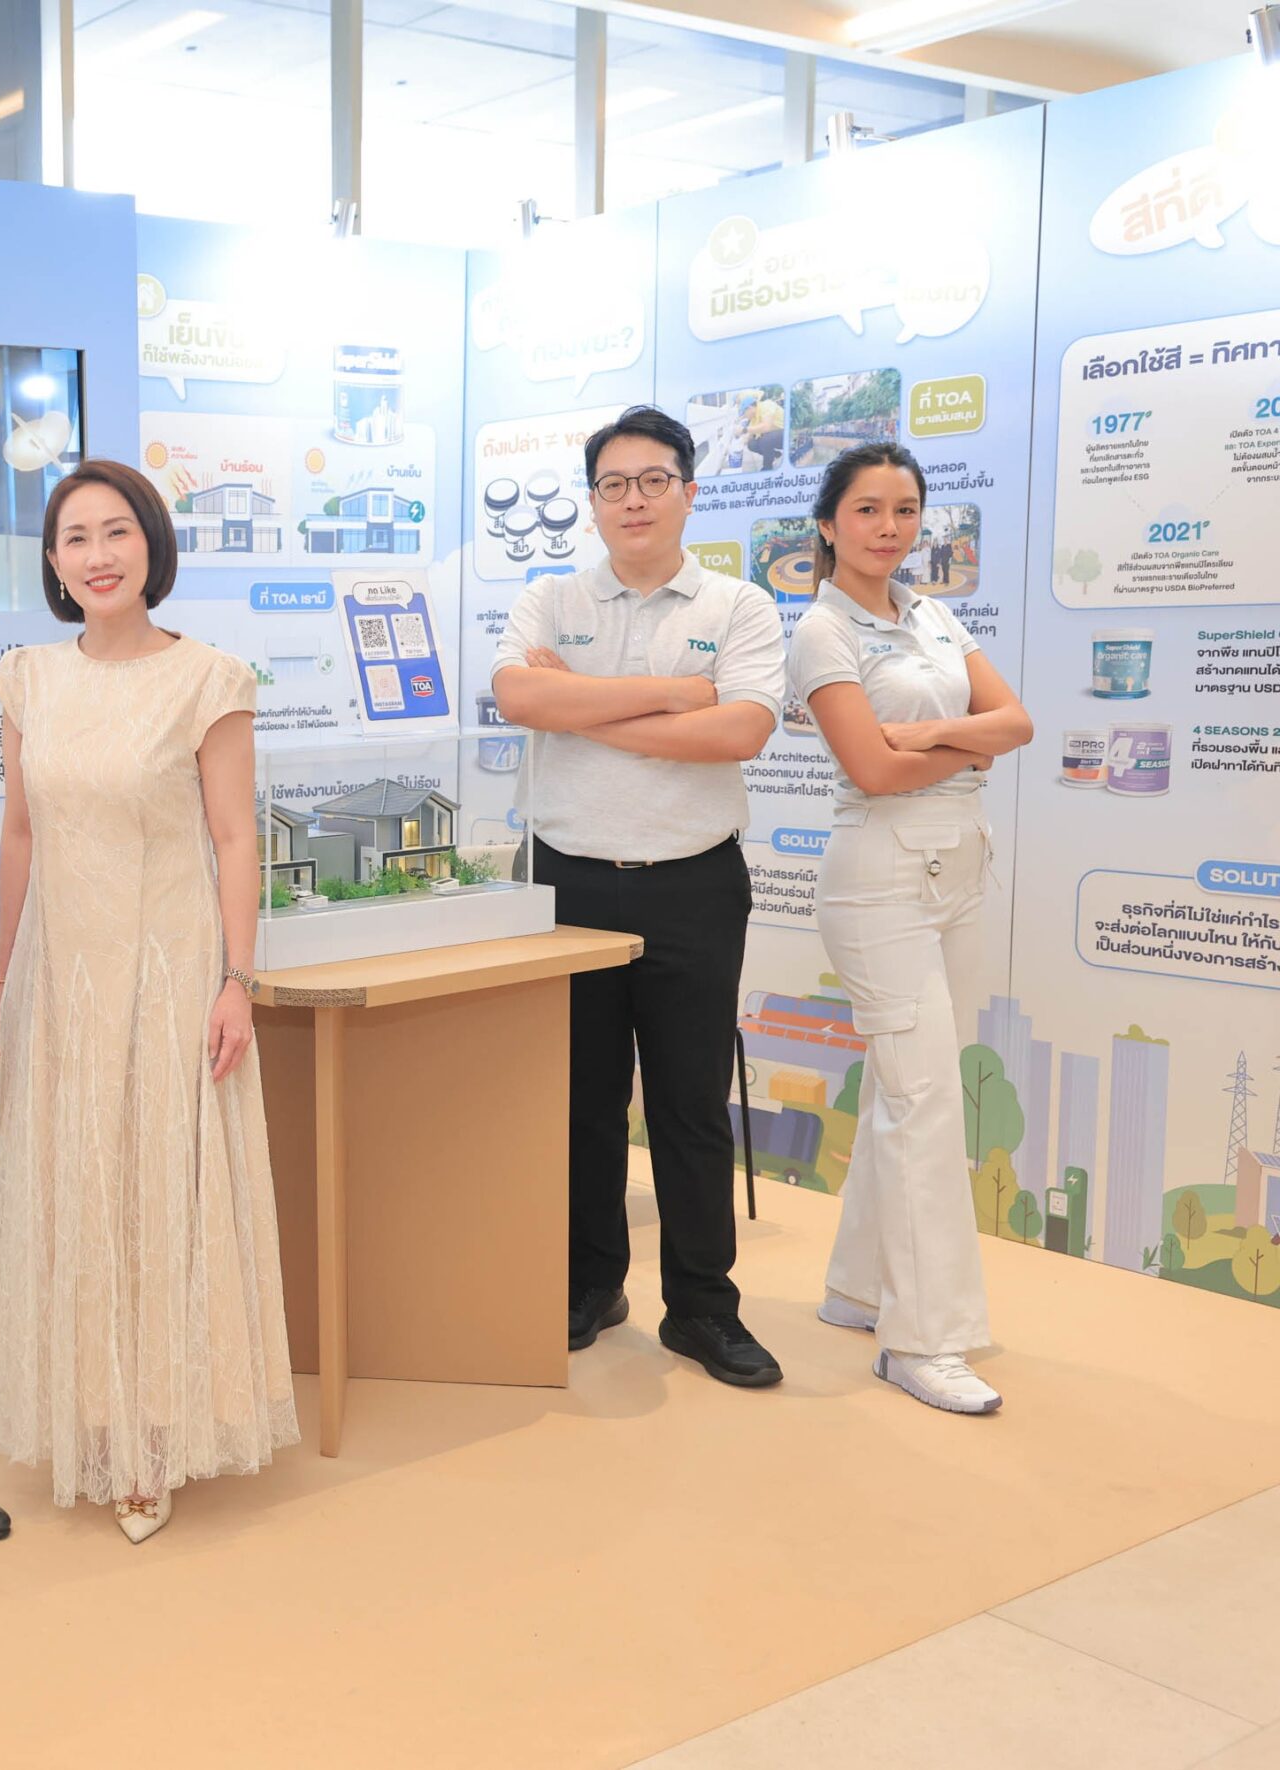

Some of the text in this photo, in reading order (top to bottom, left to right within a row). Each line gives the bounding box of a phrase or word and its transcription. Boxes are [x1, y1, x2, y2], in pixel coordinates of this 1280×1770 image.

[1082, 345, 1182, 381] เลือกใช้สี
[1189, 353, 1204, 365] =
[919, 386, 973, 409] ที่ TOA
[1092, 411, 1145, 435] 1977
[1255, 428, 1272, 436] TOA
[1238, 441, 1256, 450] TOA
[1133, 472, 1150, 481] ESG
[1148, 521, 1201, 543] 2021
[703, 554, 733, 566] TOA
[1171, 552, 1200, 560] Organic
[379, 585, 397, 594] Like
[1187, 583, 1235, 592] BioPreferred
[259, 587, 326, 605] ที่ TOA เรามี
[1197, 630, 1275, 642] SuperShield
[687, 639, 717, 653] TOA
[1197, 646, 1239, 657] จากพืช
[413, 681, 432, 692] TOA
[1195, 684, 1251, 695] มาตรฐาน
[1192, 725, 1201, 735] 4
[1204, 726, 1269, 737] SEASONS
[1081, 740, 1105, 749] PRO
